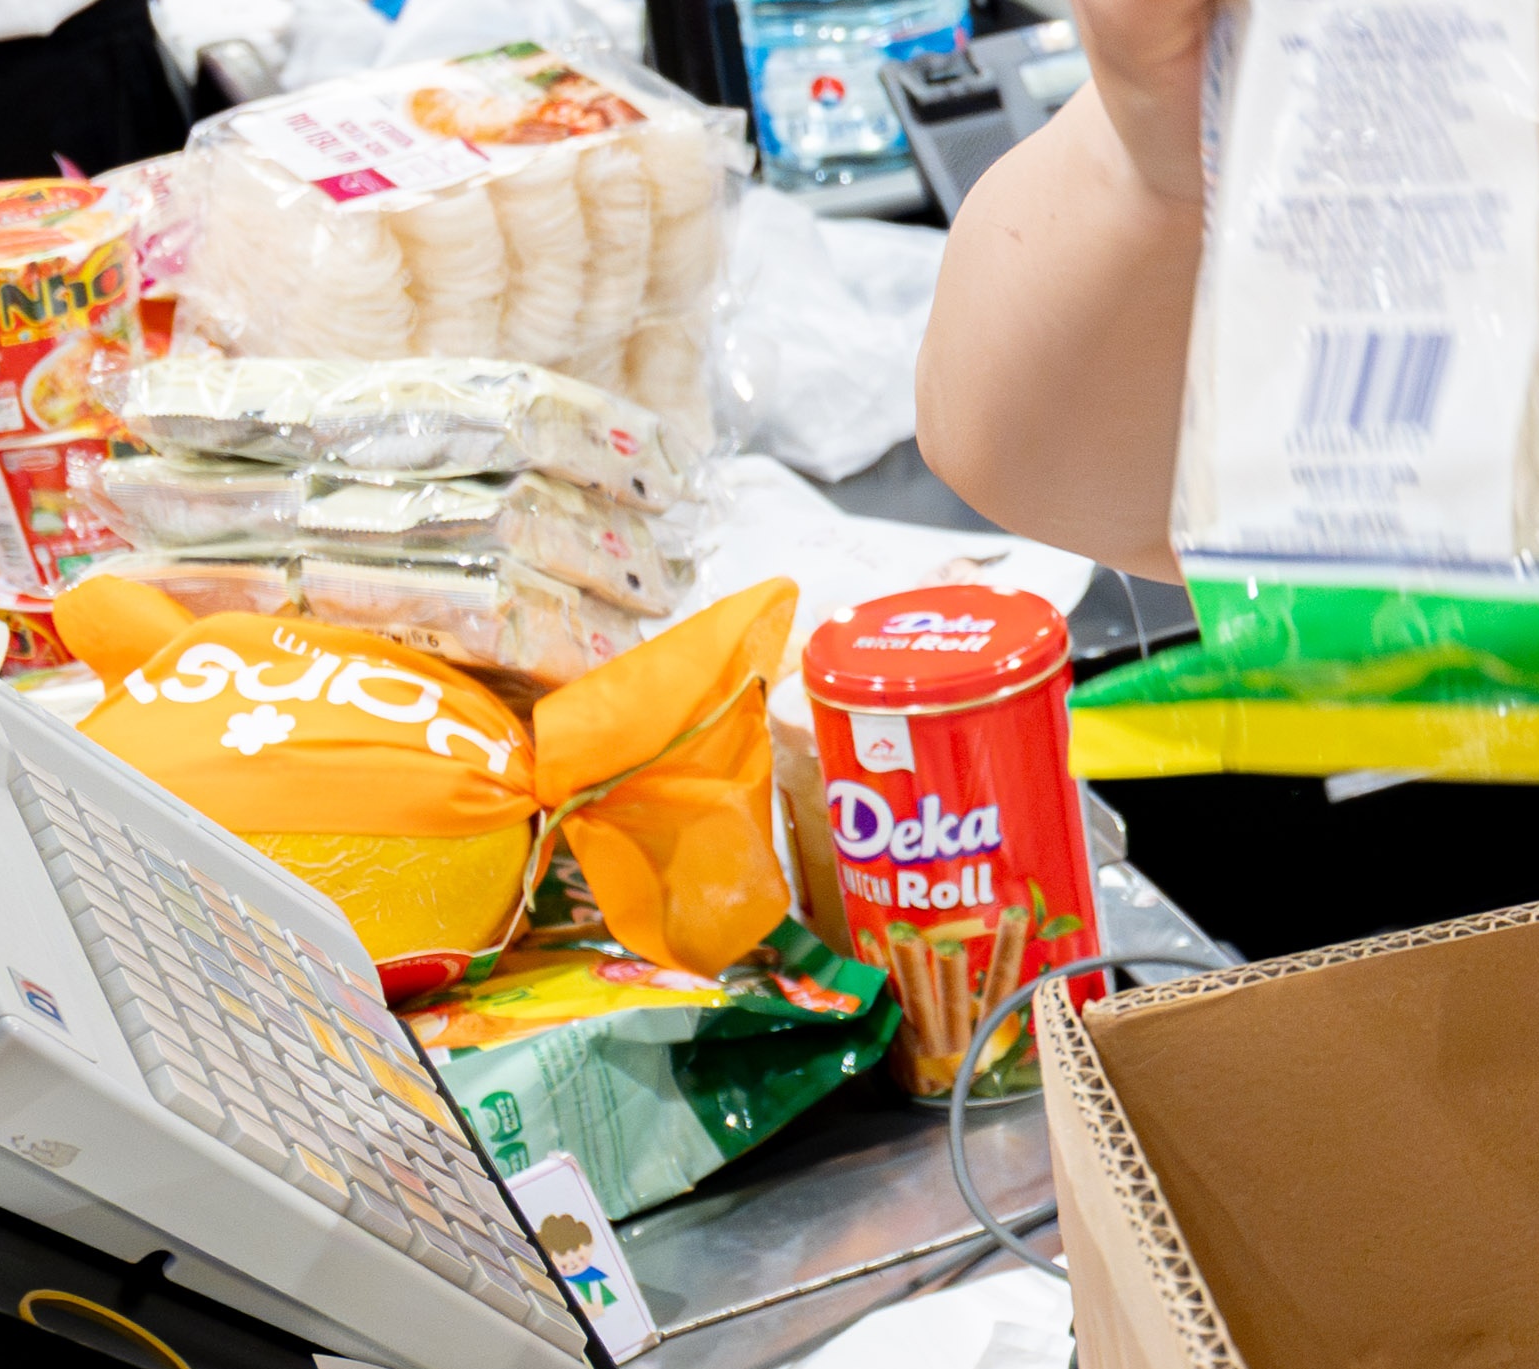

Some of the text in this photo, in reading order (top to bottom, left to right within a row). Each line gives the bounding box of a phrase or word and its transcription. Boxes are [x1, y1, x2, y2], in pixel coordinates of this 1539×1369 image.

[882, 610, 996, 635] Deka
[911, 633, 993, 653] Roll
[827, 779, 1002, 866] Deka
[896, 862, 995, 910] Roll
